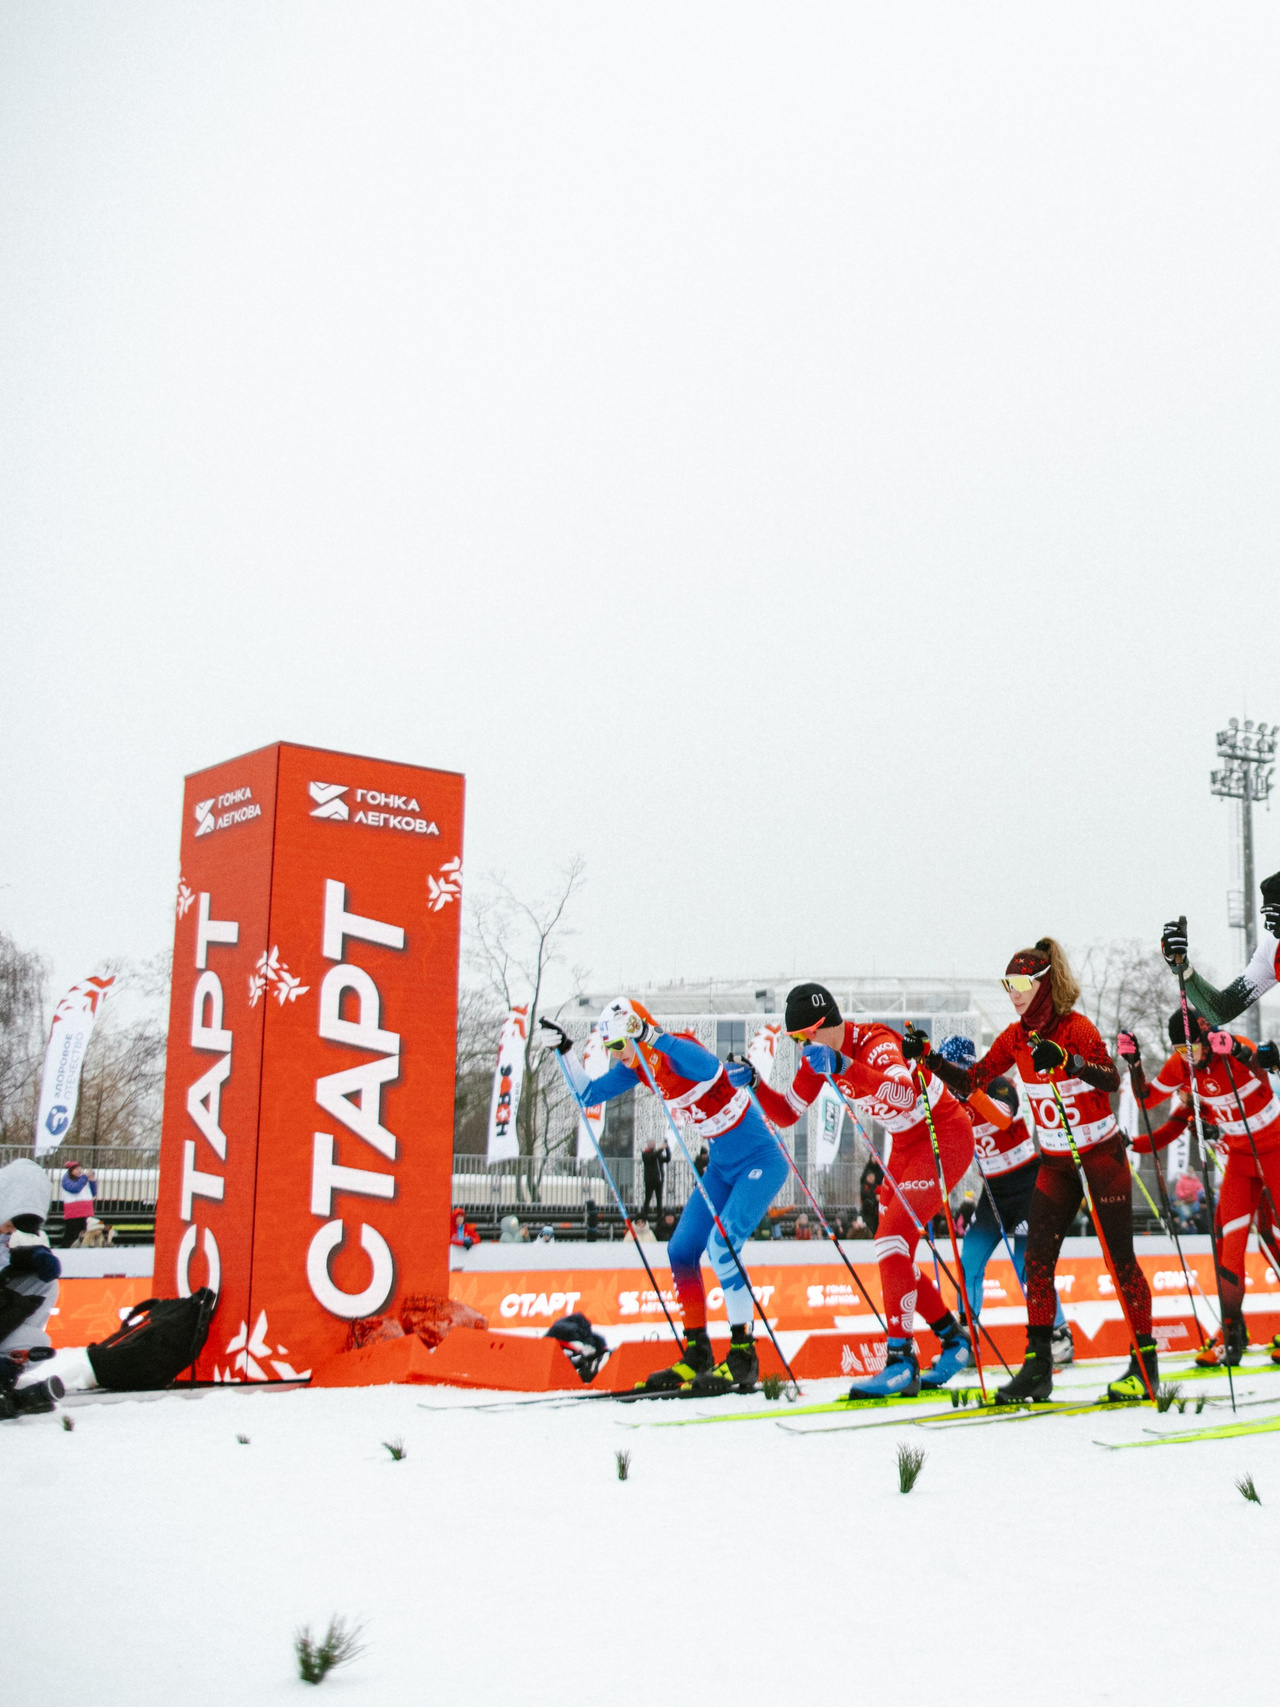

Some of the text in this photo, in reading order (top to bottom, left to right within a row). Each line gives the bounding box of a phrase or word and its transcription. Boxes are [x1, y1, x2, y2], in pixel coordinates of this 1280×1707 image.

[218, 786, 252, 809] ГОНКА
[356, 788, 421, 812] ГОНКА
[216, 804, 262, 830] ЛЕГКОВА
[354, 811, 440, 836] ЛЕГКОВА
[811, 993, 827, 1007] 01
[177, 892, 239, 1311] СТАРТ
[307, 878, 405, 1319] СТАРТ
[897, 1179, 929, 1190] OSCO
[499, 1291, 581, 1318] СТАРТ
